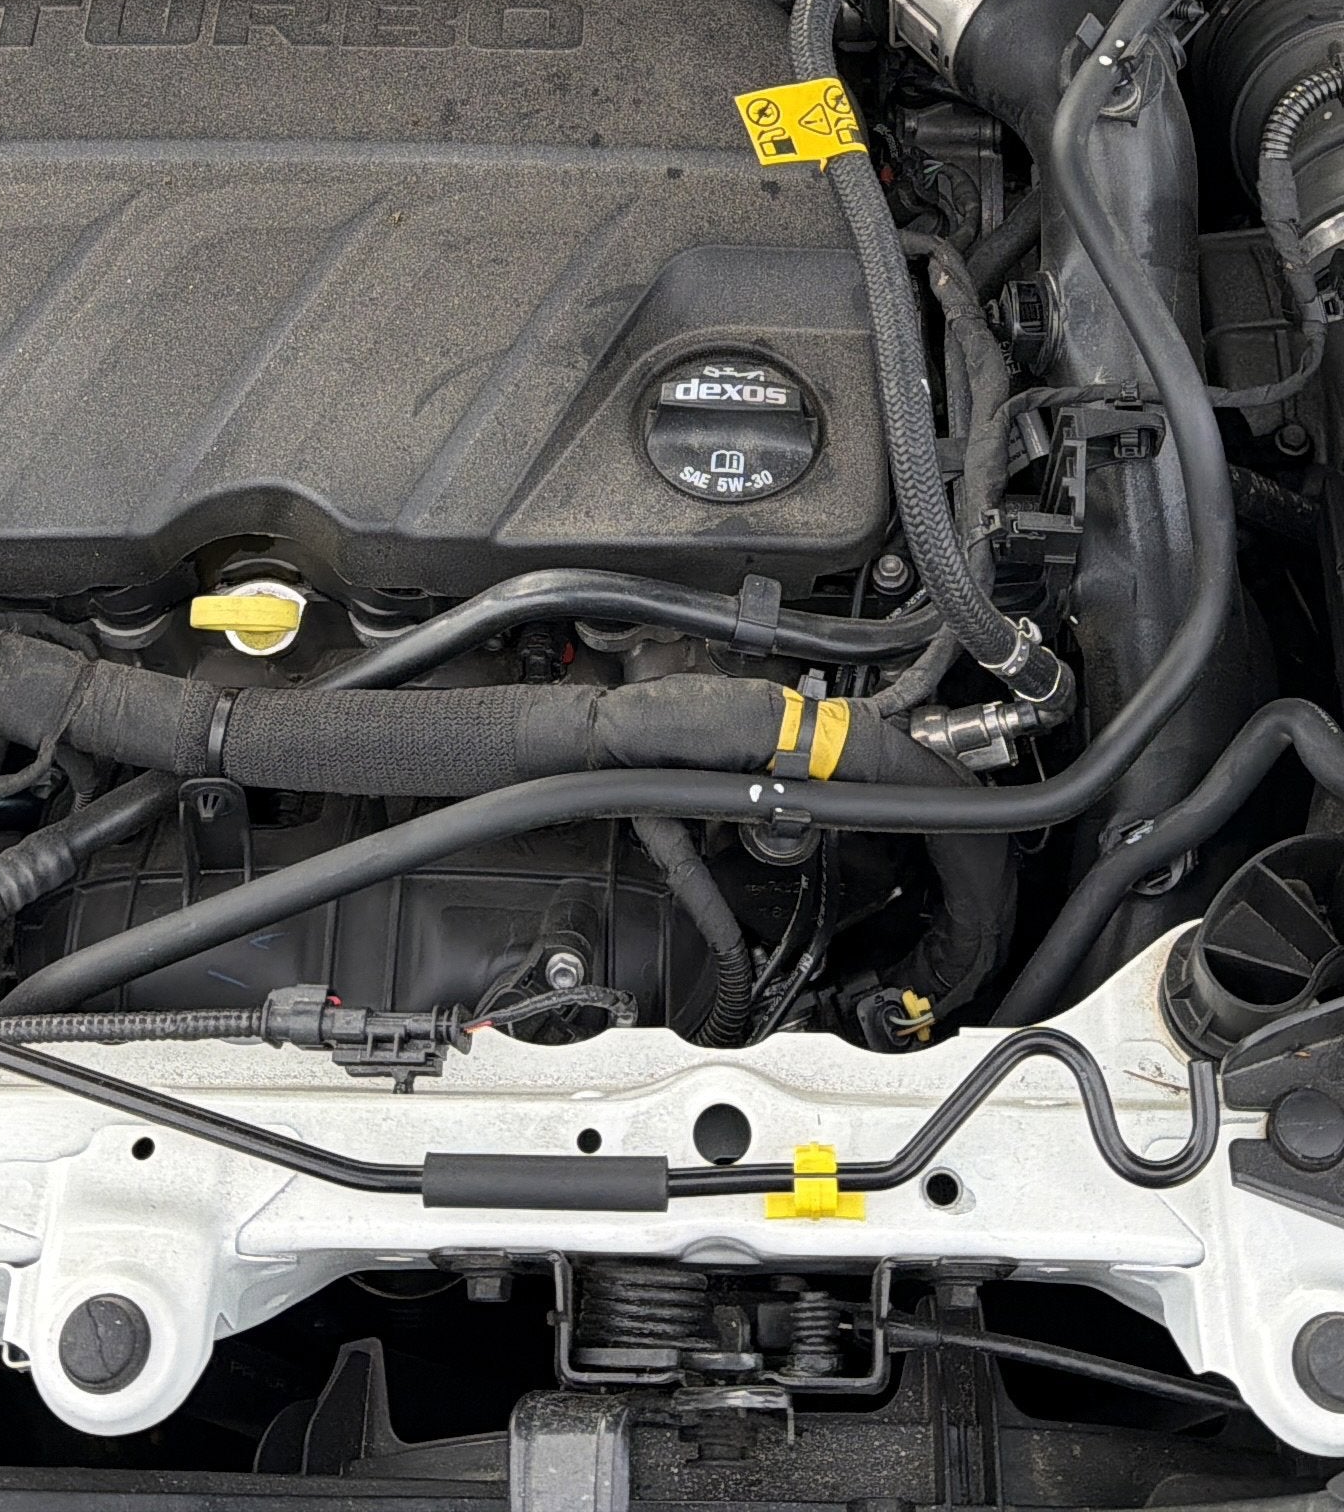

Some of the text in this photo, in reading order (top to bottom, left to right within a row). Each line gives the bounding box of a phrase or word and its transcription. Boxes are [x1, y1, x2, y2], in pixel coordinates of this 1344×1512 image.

[675, 378, 787, 405] dexos
[679, 466, 773, 493] SAE 5W-30
